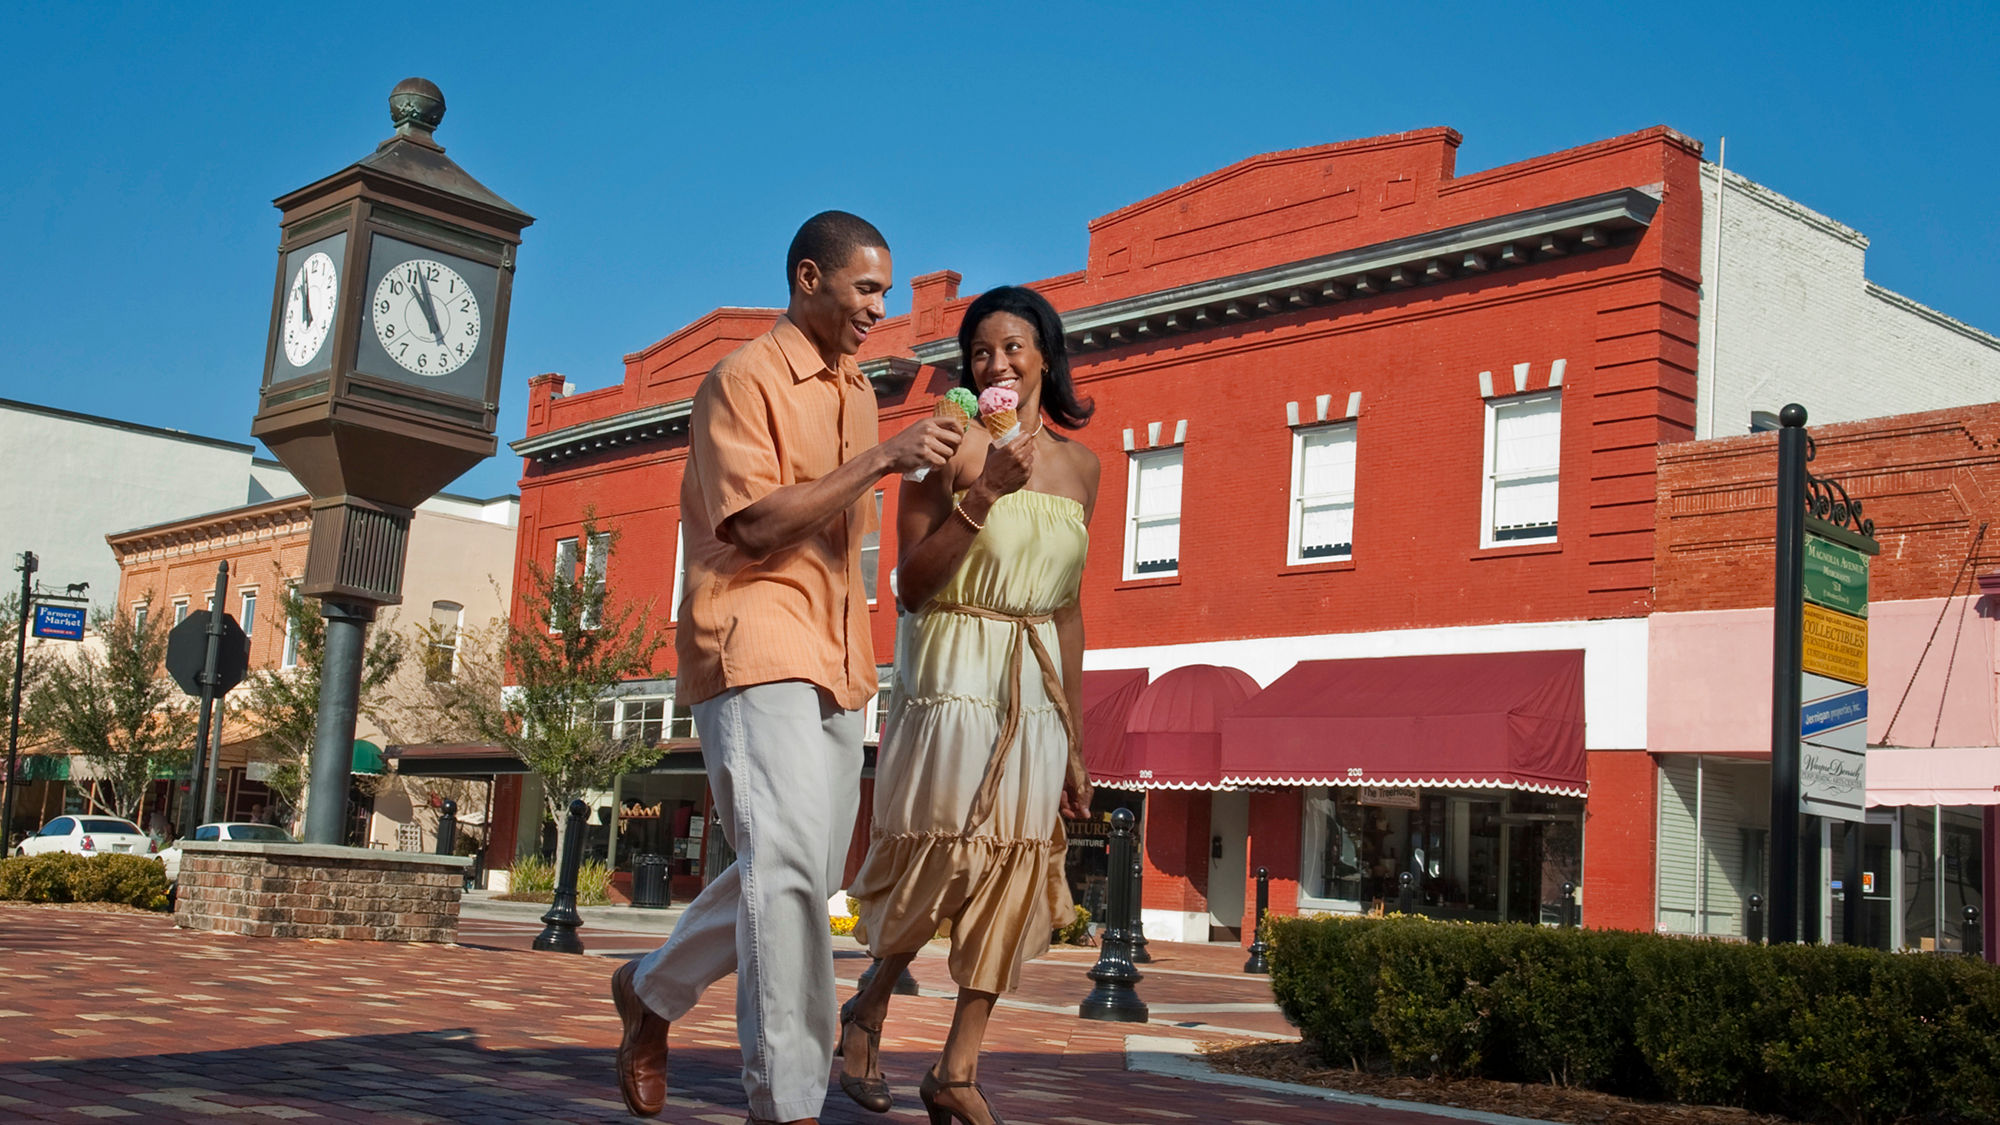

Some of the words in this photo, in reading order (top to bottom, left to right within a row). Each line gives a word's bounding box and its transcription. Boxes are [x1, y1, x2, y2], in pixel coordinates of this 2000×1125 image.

[407, 269, 417, 284] 11
[426, 266, 439, 282] 12
[390, 279, 403, 295] 10
[449, 279, 454, 293] 1
[380, 300, 390, 314] 9
[461, 299, 470, 313] 2
[385, 324, 395, 338] 8
[465, 322, 475, 336] 3
[399, 343, 409, 357] 7
[455, 343, 464, 356] 4
[417, 354, 427, 367] 6
[438, 353, 448, 367] 5
[1841, 557, 1865, 575] AVENUE
[40, 607, 77, 618] Farmers
[45, 616, 81, 627] Market
[1803, 619, 1865, 648] COLLECTIBLES
[1805, 711, 1830, 725] Jernigan
[1364, 787, 1377, 798] The
